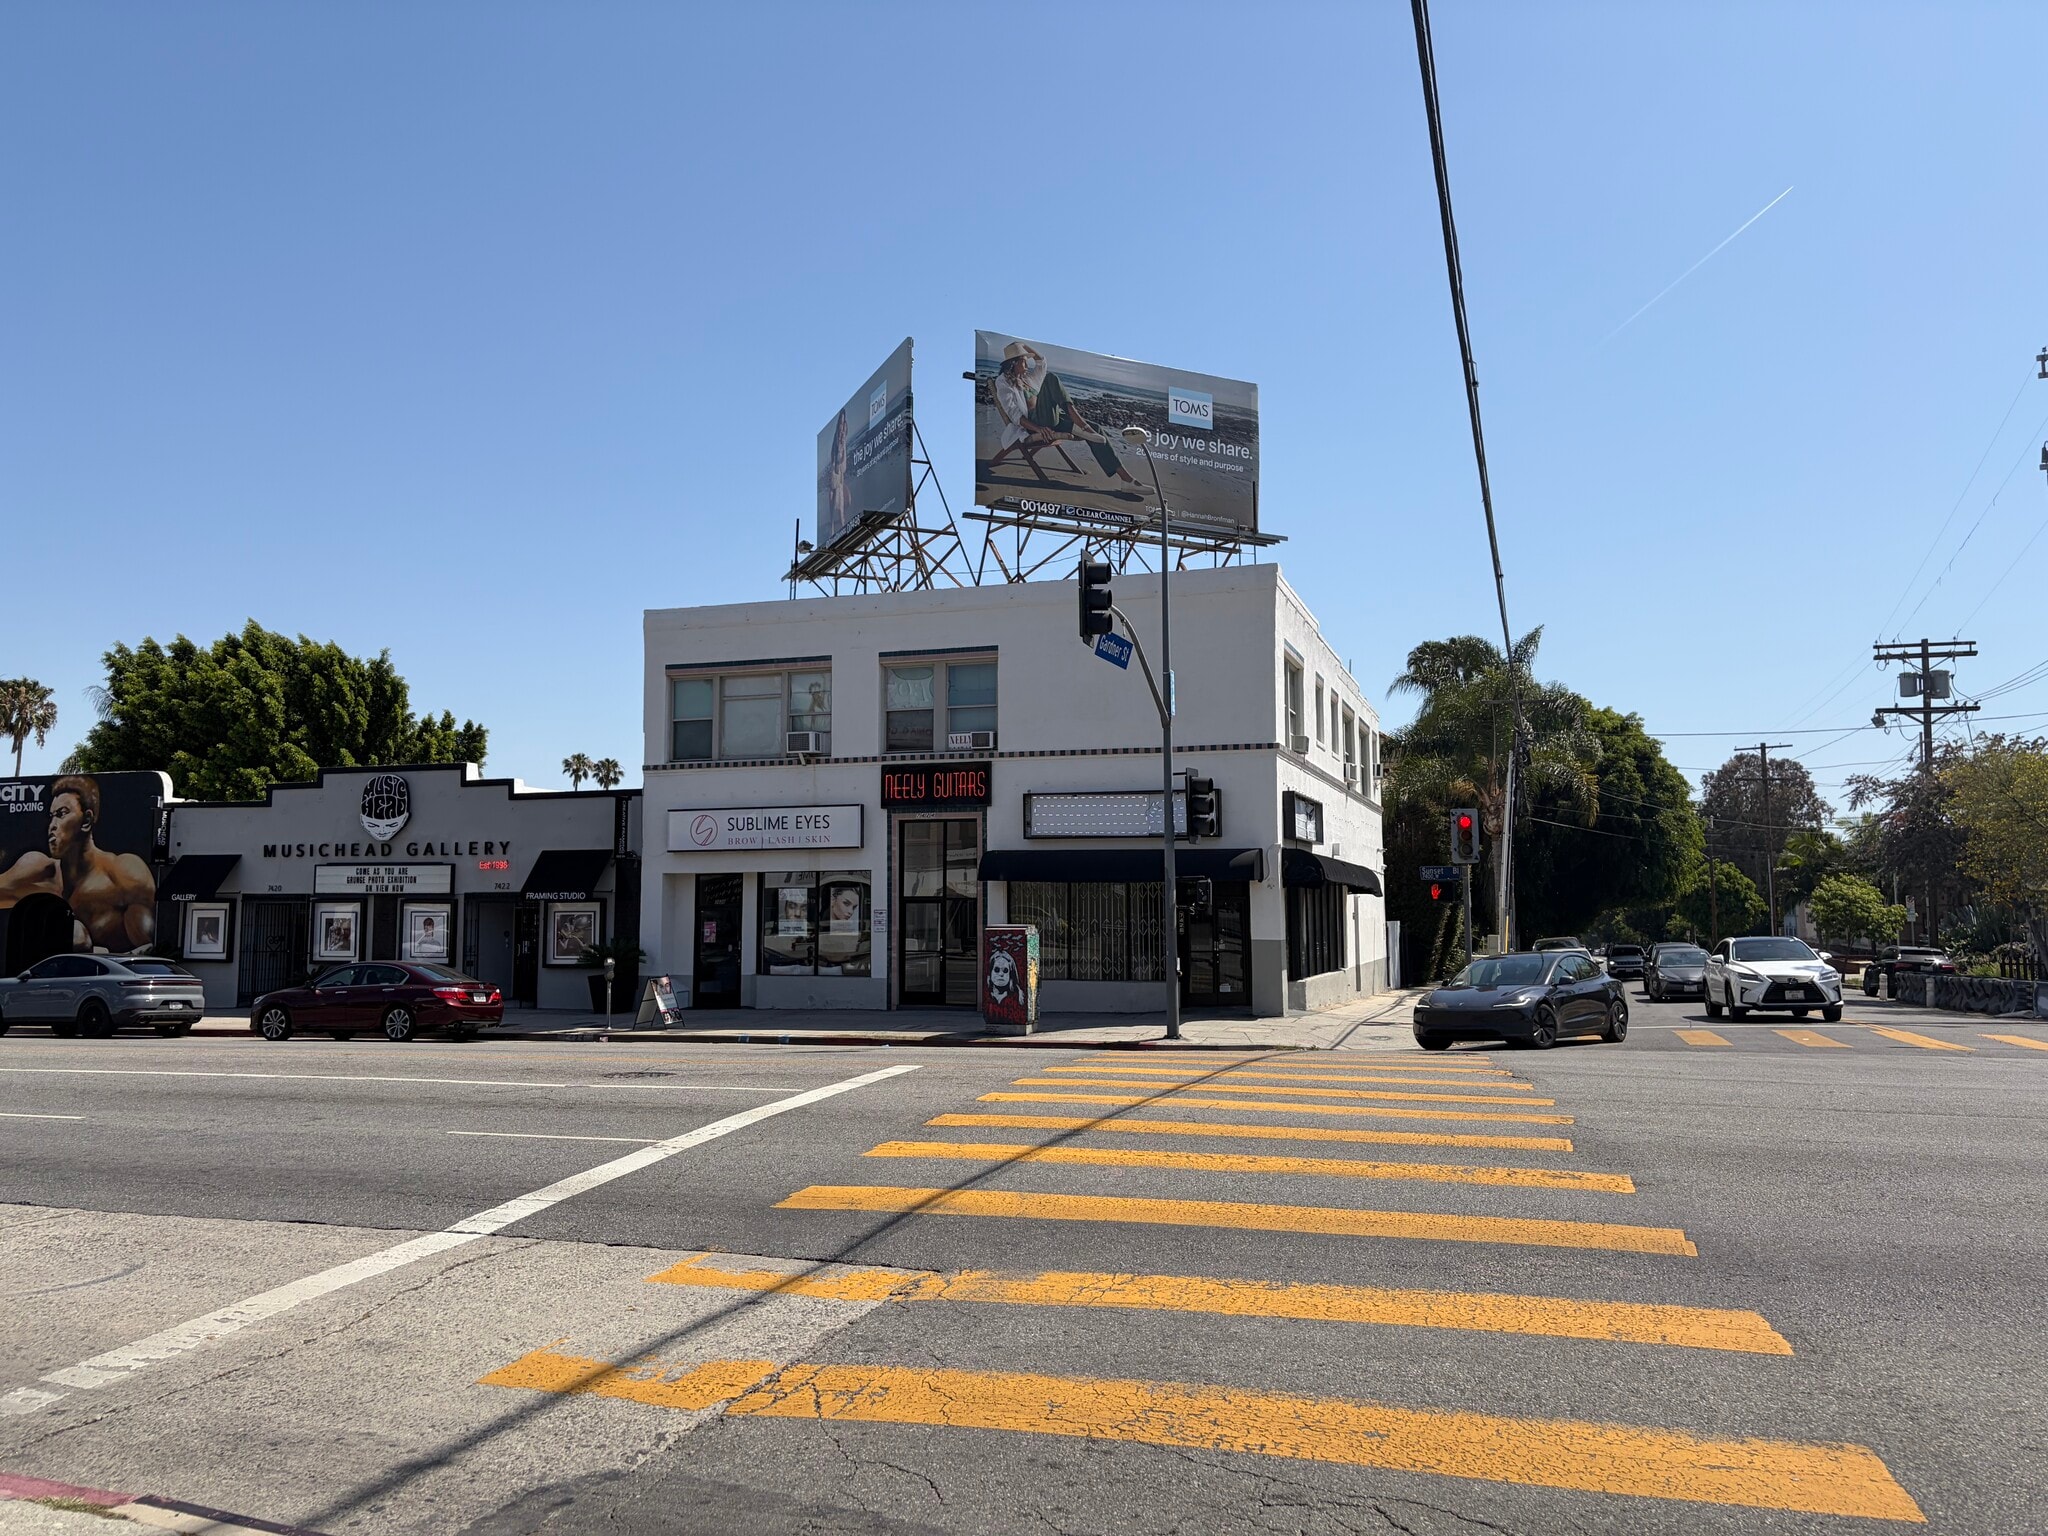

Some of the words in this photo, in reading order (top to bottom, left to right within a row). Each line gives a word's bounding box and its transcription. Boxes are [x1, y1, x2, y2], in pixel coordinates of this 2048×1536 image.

[871, 393, 886, 416] TOMS
[1173, 398, 1209, 418] TOMS
[853, 446, 864, 466] the
[863, 439, 874, 461] joy
[873, 432, 883, 448] we
[1155, 428, 1179, 450] joy
[1182, 436, 1206, 451] we
[1208, 438, 1253, 460] share.
[1170, 453, 1179, 461] of
[1179, 454, 1198, 466] style
[1199, 457, 1214, 467] and
[1214, 461, 1244, 473] purpose
[1021, 499, 1060, 515] 001497
[1121, 646, 1129, 661] St
[885, 773, 925, 799] NEELY
[933, 771, 986, 798] GUITARS
[0, 785, 46, 801] CITY
[10, 802, 44, 813] BOXING
[727, 816, 788, 831] SUBLIME
[795, 814, 830, 829] EYES
[728, 836, 757, 846] BROW
[768, 835, 795, 845] LASH
[805, 834, 830, 843] SKIN
[263, 843, 392, 858] MUSICHEAD
[406, 841, 510, 856] GALLERY
[355, 867, 370, 876] COME
[373, 867, 380, 876] AS
[384, 867, 394, 876] YOU
[398, 867, 408, 876] ARE
[1421, 867, 1444, 875] Sunset
[367, 876, 385, 884] PHOTO
[387, 876, 417, 884] EXHIBITION
[494, 882, 510, 890] 7422
[365, 884, 372, 893] ON
[375, 884, 389, 893] VIEW
[391, 884, 404, 893] NOW
[525, 892, 559, 900] FRAMING
[559, 892, 586, 900] STUDIO
[171, 893, 197, 901] GALLERY
